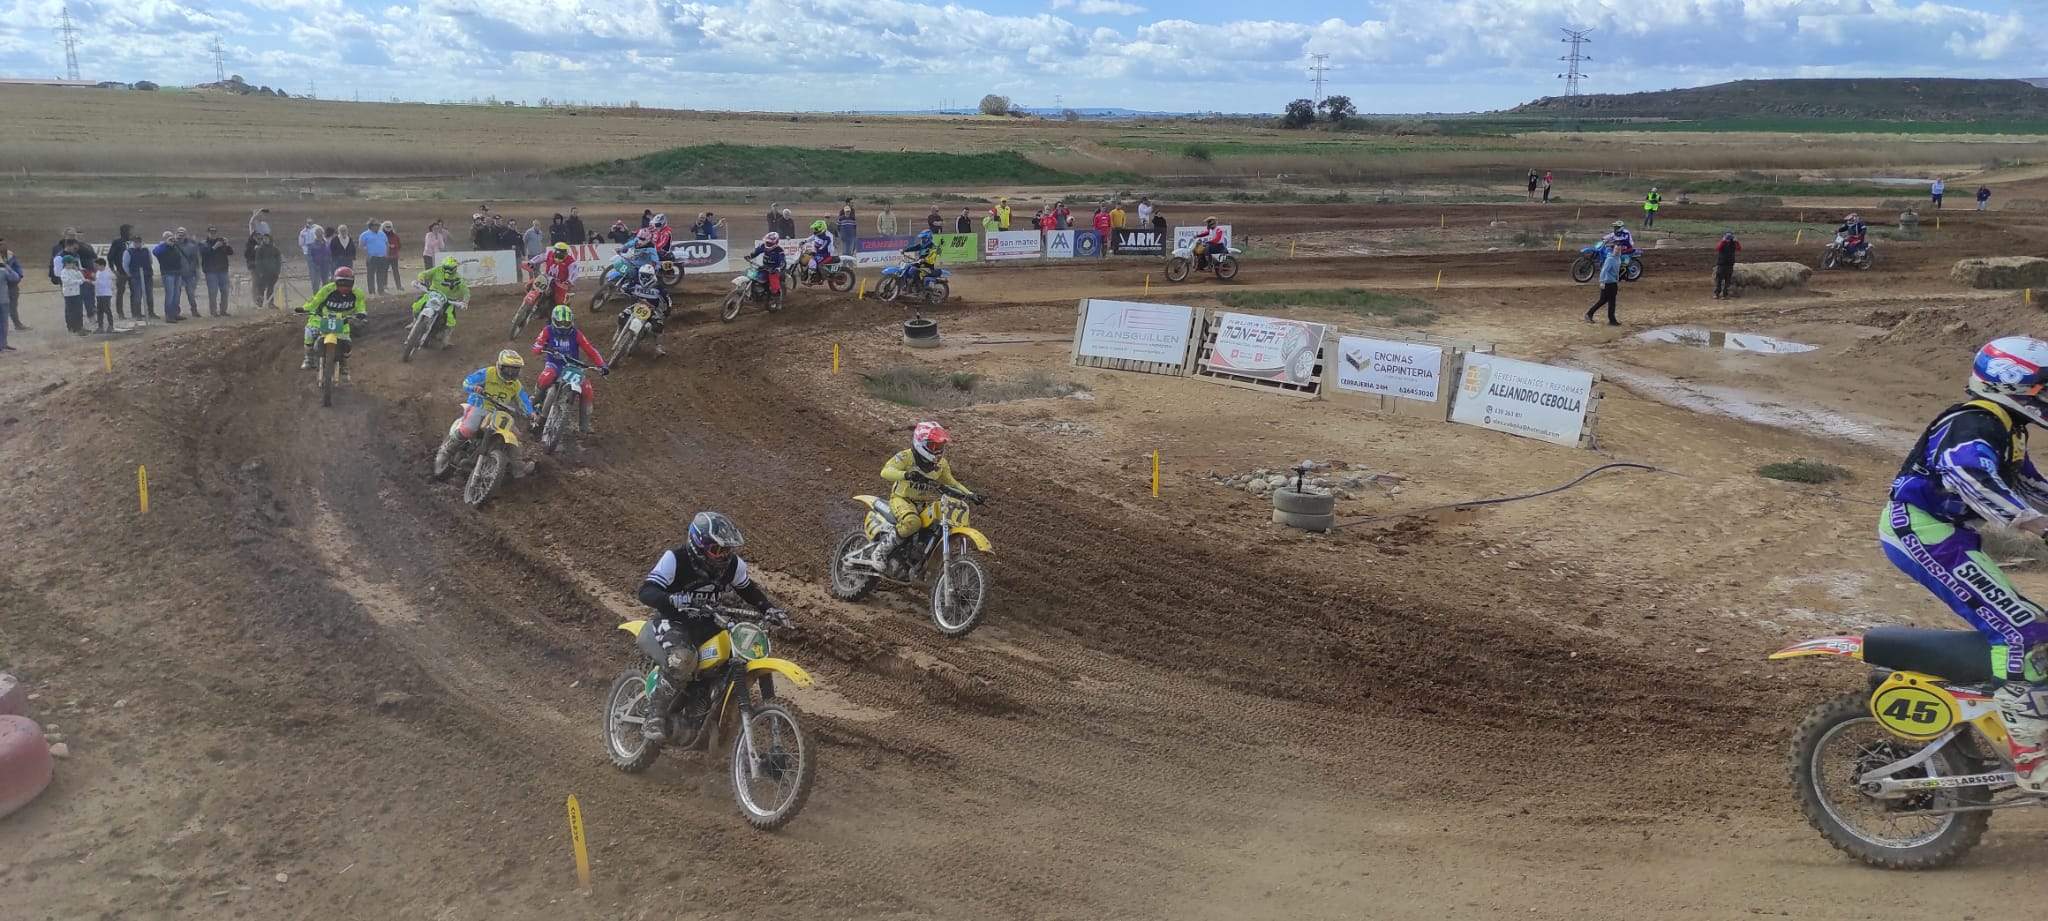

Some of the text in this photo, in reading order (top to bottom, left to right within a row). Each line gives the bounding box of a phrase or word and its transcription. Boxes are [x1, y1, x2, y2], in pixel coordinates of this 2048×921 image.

[1000, 239, 1014, 247] san
[1222, 326, 1286, 345] MONFORT
[1374, 352, 1414, 364] ENCINAS
[1373, 363, 1433, 378] CARPINTERIA
[1488, 383, 1581, 413] ALEJANDRO CEBOLLA
[1902, 533, 1972, 602] SINISALO
[1957, 563, 2033, 625] SINISALO
[1883, 698, 1941, 724] 45
[1955, 775, 2006, 785] LARSSON
